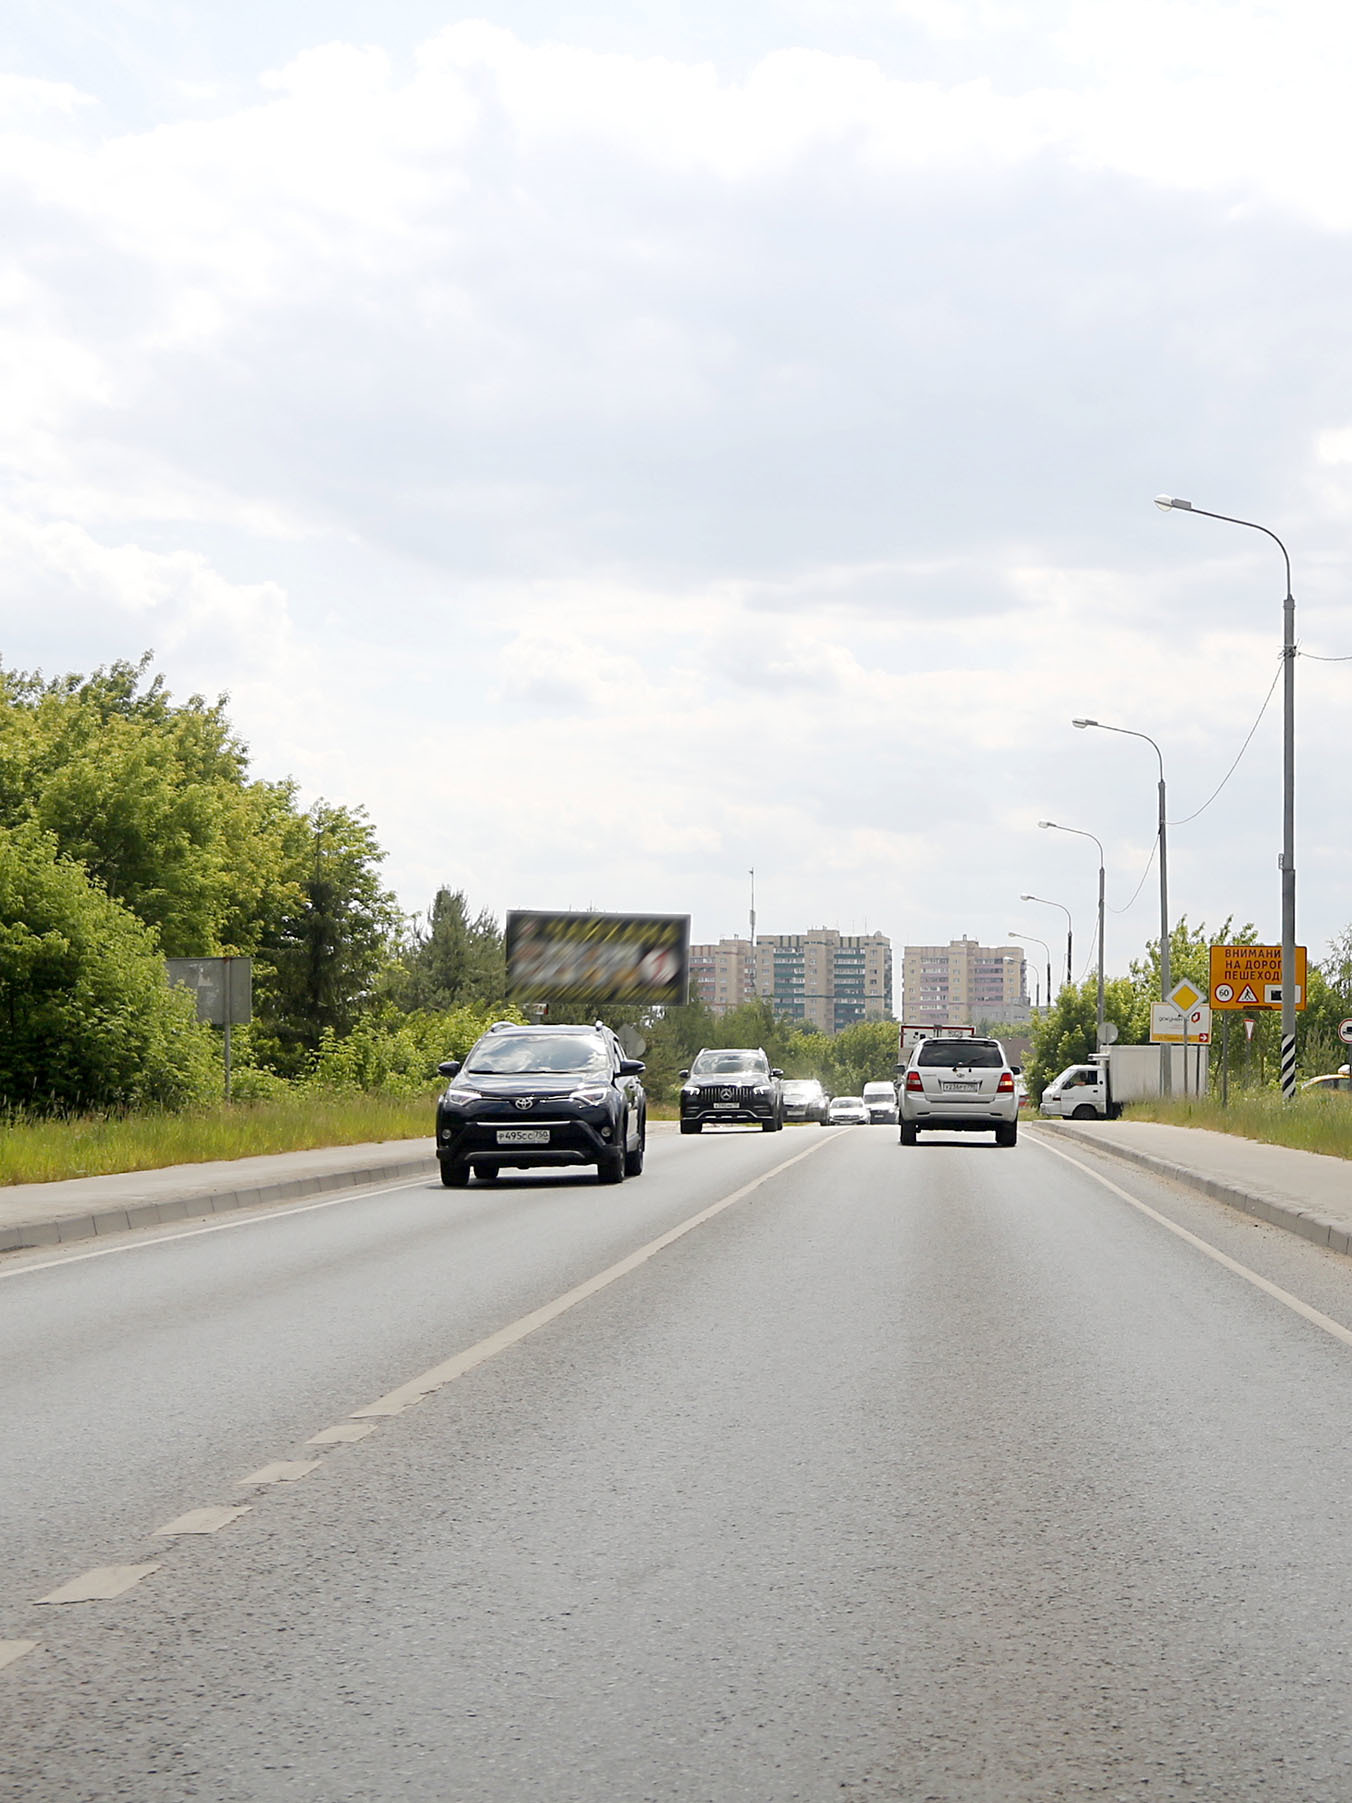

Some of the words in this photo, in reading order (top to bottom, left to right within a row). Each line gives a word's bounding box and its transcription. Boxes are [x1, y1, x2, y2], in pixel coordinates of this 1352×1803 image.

[1225, 949, 1283, 958] ВНИМАНИ
[1225, 960, 1241, 969] НА
[1245, 960, 1283, 970] ДОРОГ
[1224, 971, 1283, 981] ПЕШЕХОД
[1219, 989, 1230, 997] 60
